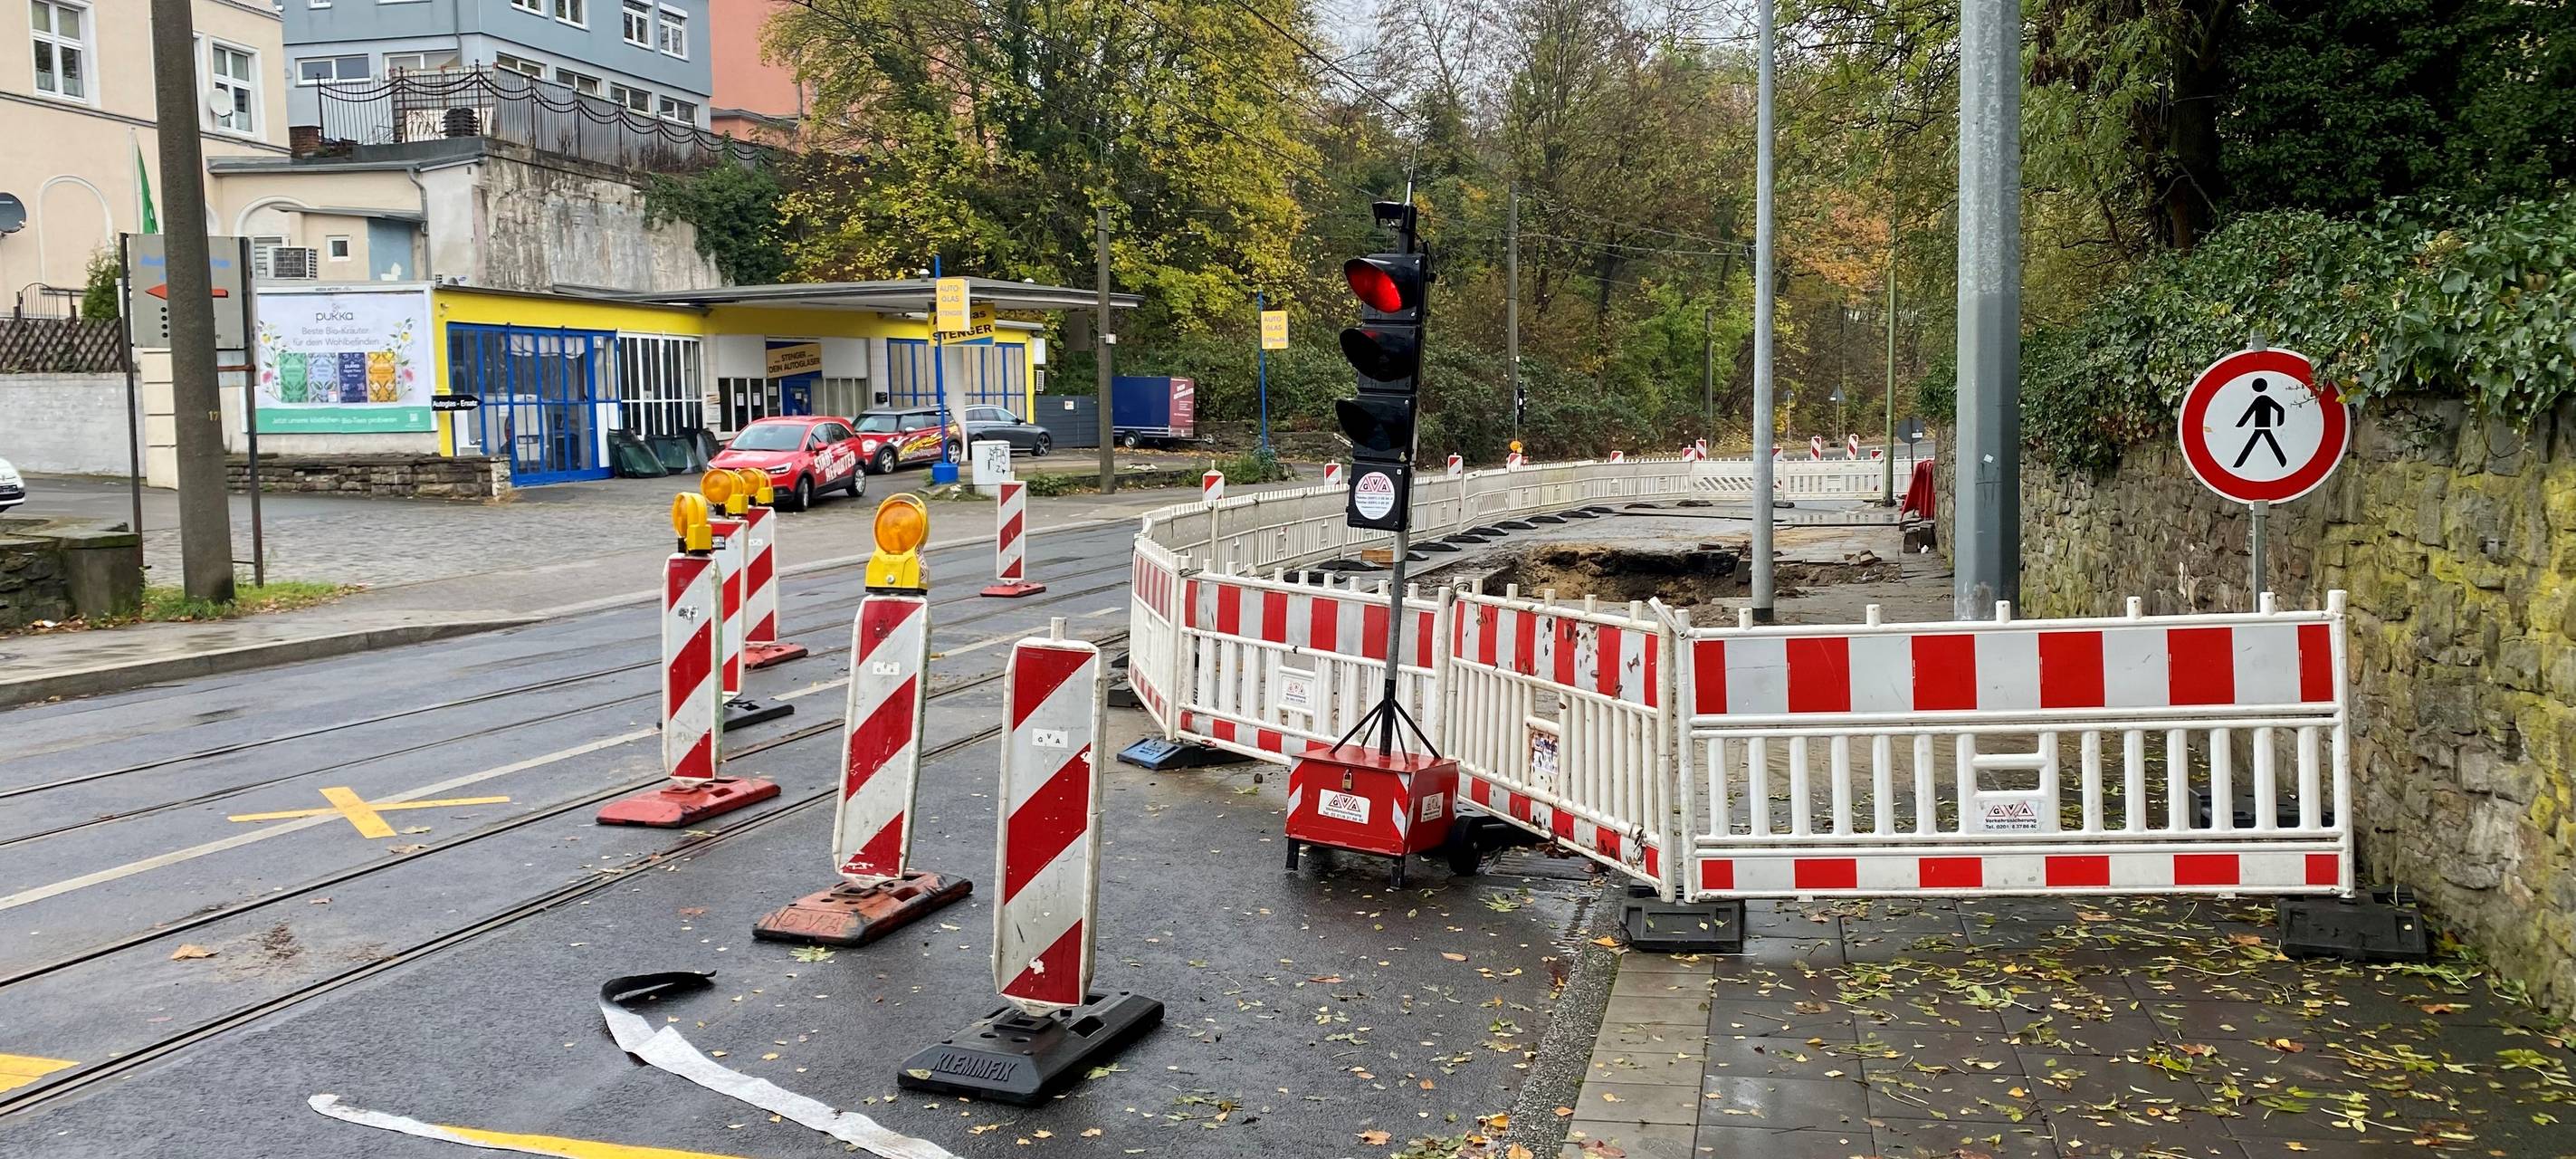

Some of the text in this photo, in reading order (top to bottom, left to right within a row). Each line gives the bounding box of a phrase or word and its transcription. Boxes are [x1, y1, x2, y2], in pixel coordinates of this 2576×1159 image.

[316, 311, 354, 323] pukka
[301, 327, 324, 335] Beste
[932, 324, 992, 341] STENGER
[292, 338, 380, 347] für dein Wohlbefinden
[433, 400, 456, 408] Autoglas
[931, 1052, 1018, 1083] KLEMMFIX
